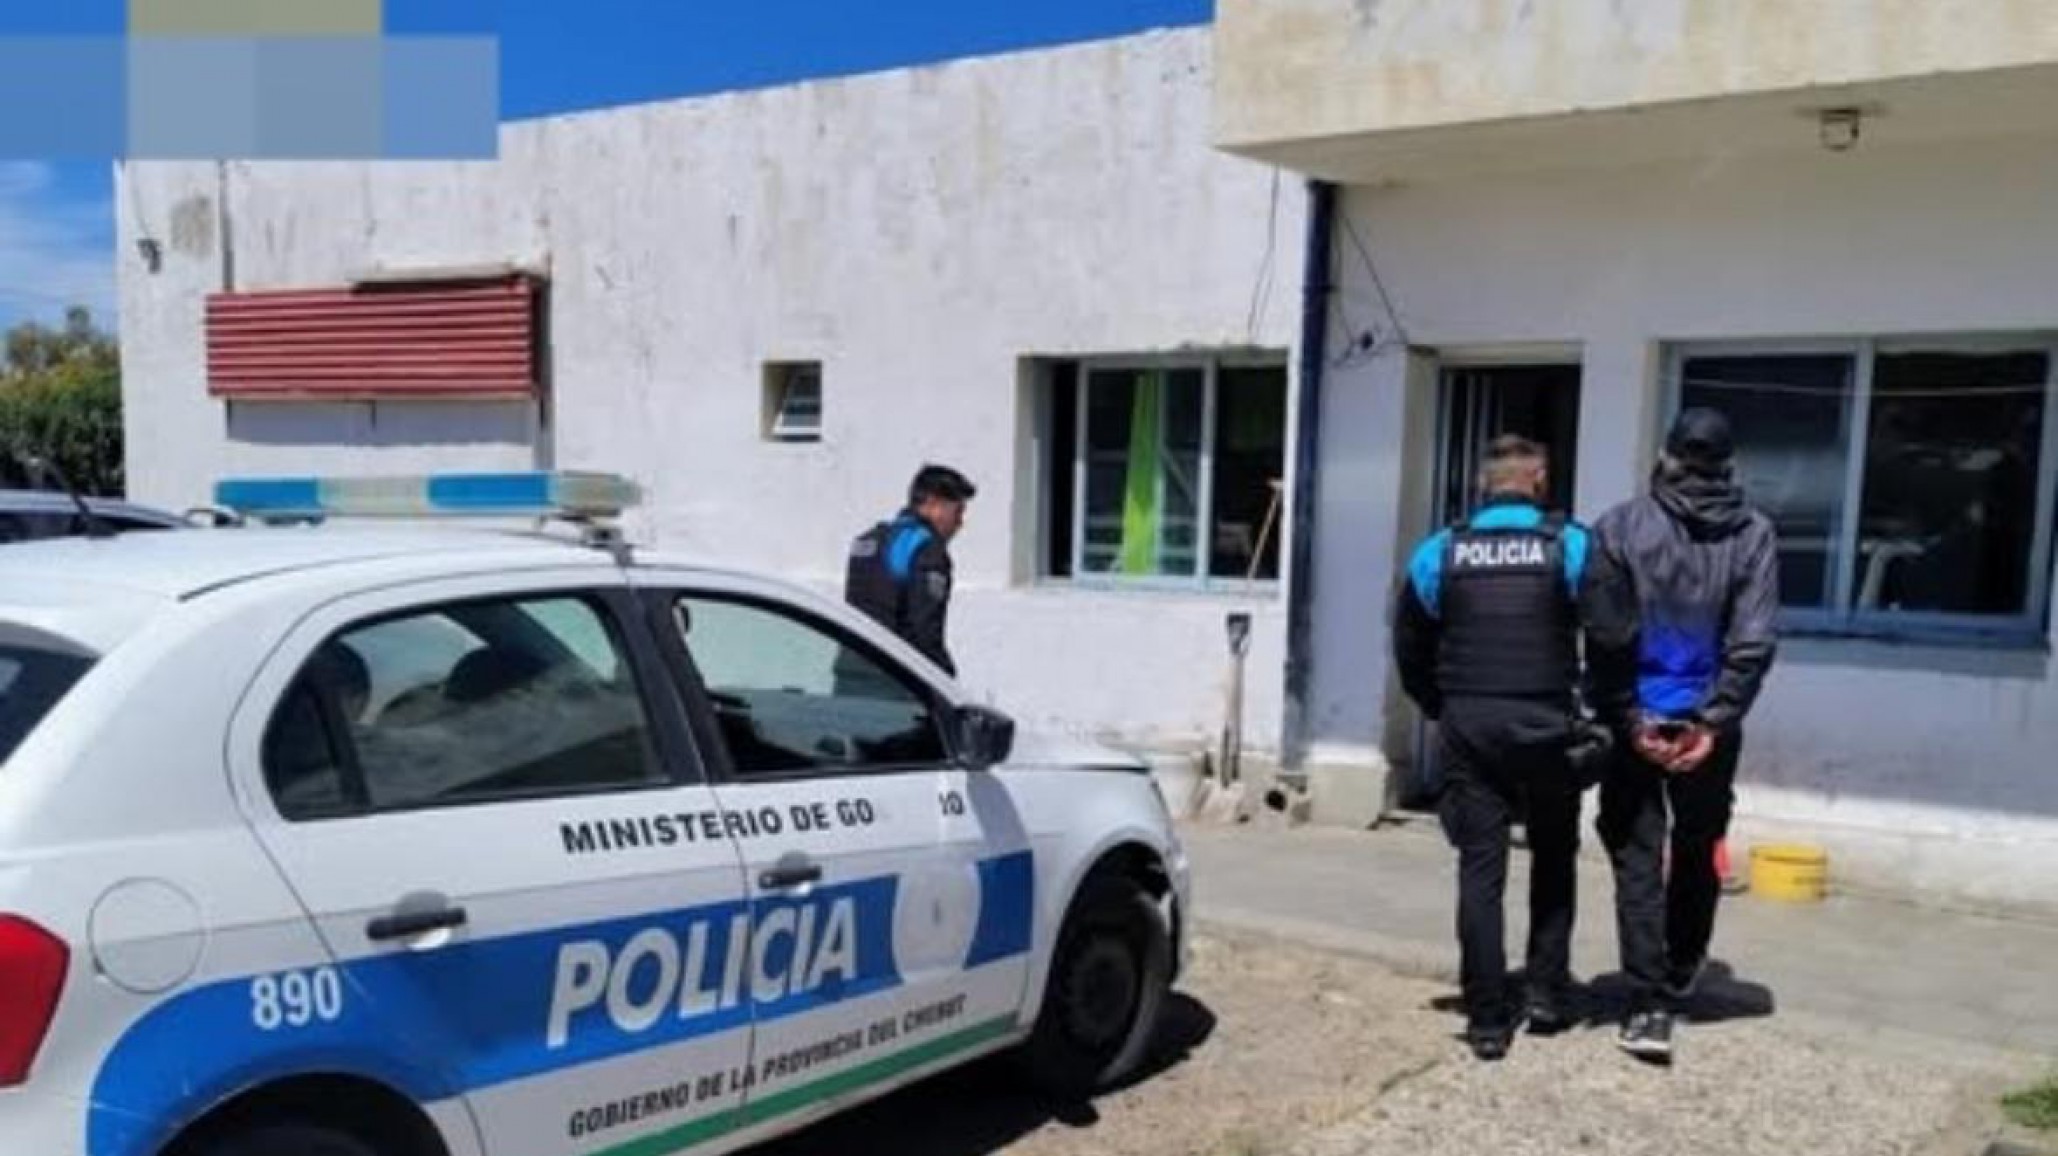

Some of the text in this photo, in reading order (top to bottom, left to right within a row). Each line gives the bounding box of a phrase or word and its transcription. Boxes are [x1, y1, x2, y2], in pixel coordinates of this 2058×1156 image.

[560, 805, 783, 853] MINISTERIO
[789, 803, 830, 832] DE
[250, 965, 342, 1030] 890
[568, 1080, 689, 1138] GOBIERNO
[696, 1070, 725, 1101] DE
[730, 1064, 757, 1092] LA
[762, 1029, 863, 1081] PROVINCIA
[867, 1017, 897, 1046] DEL
